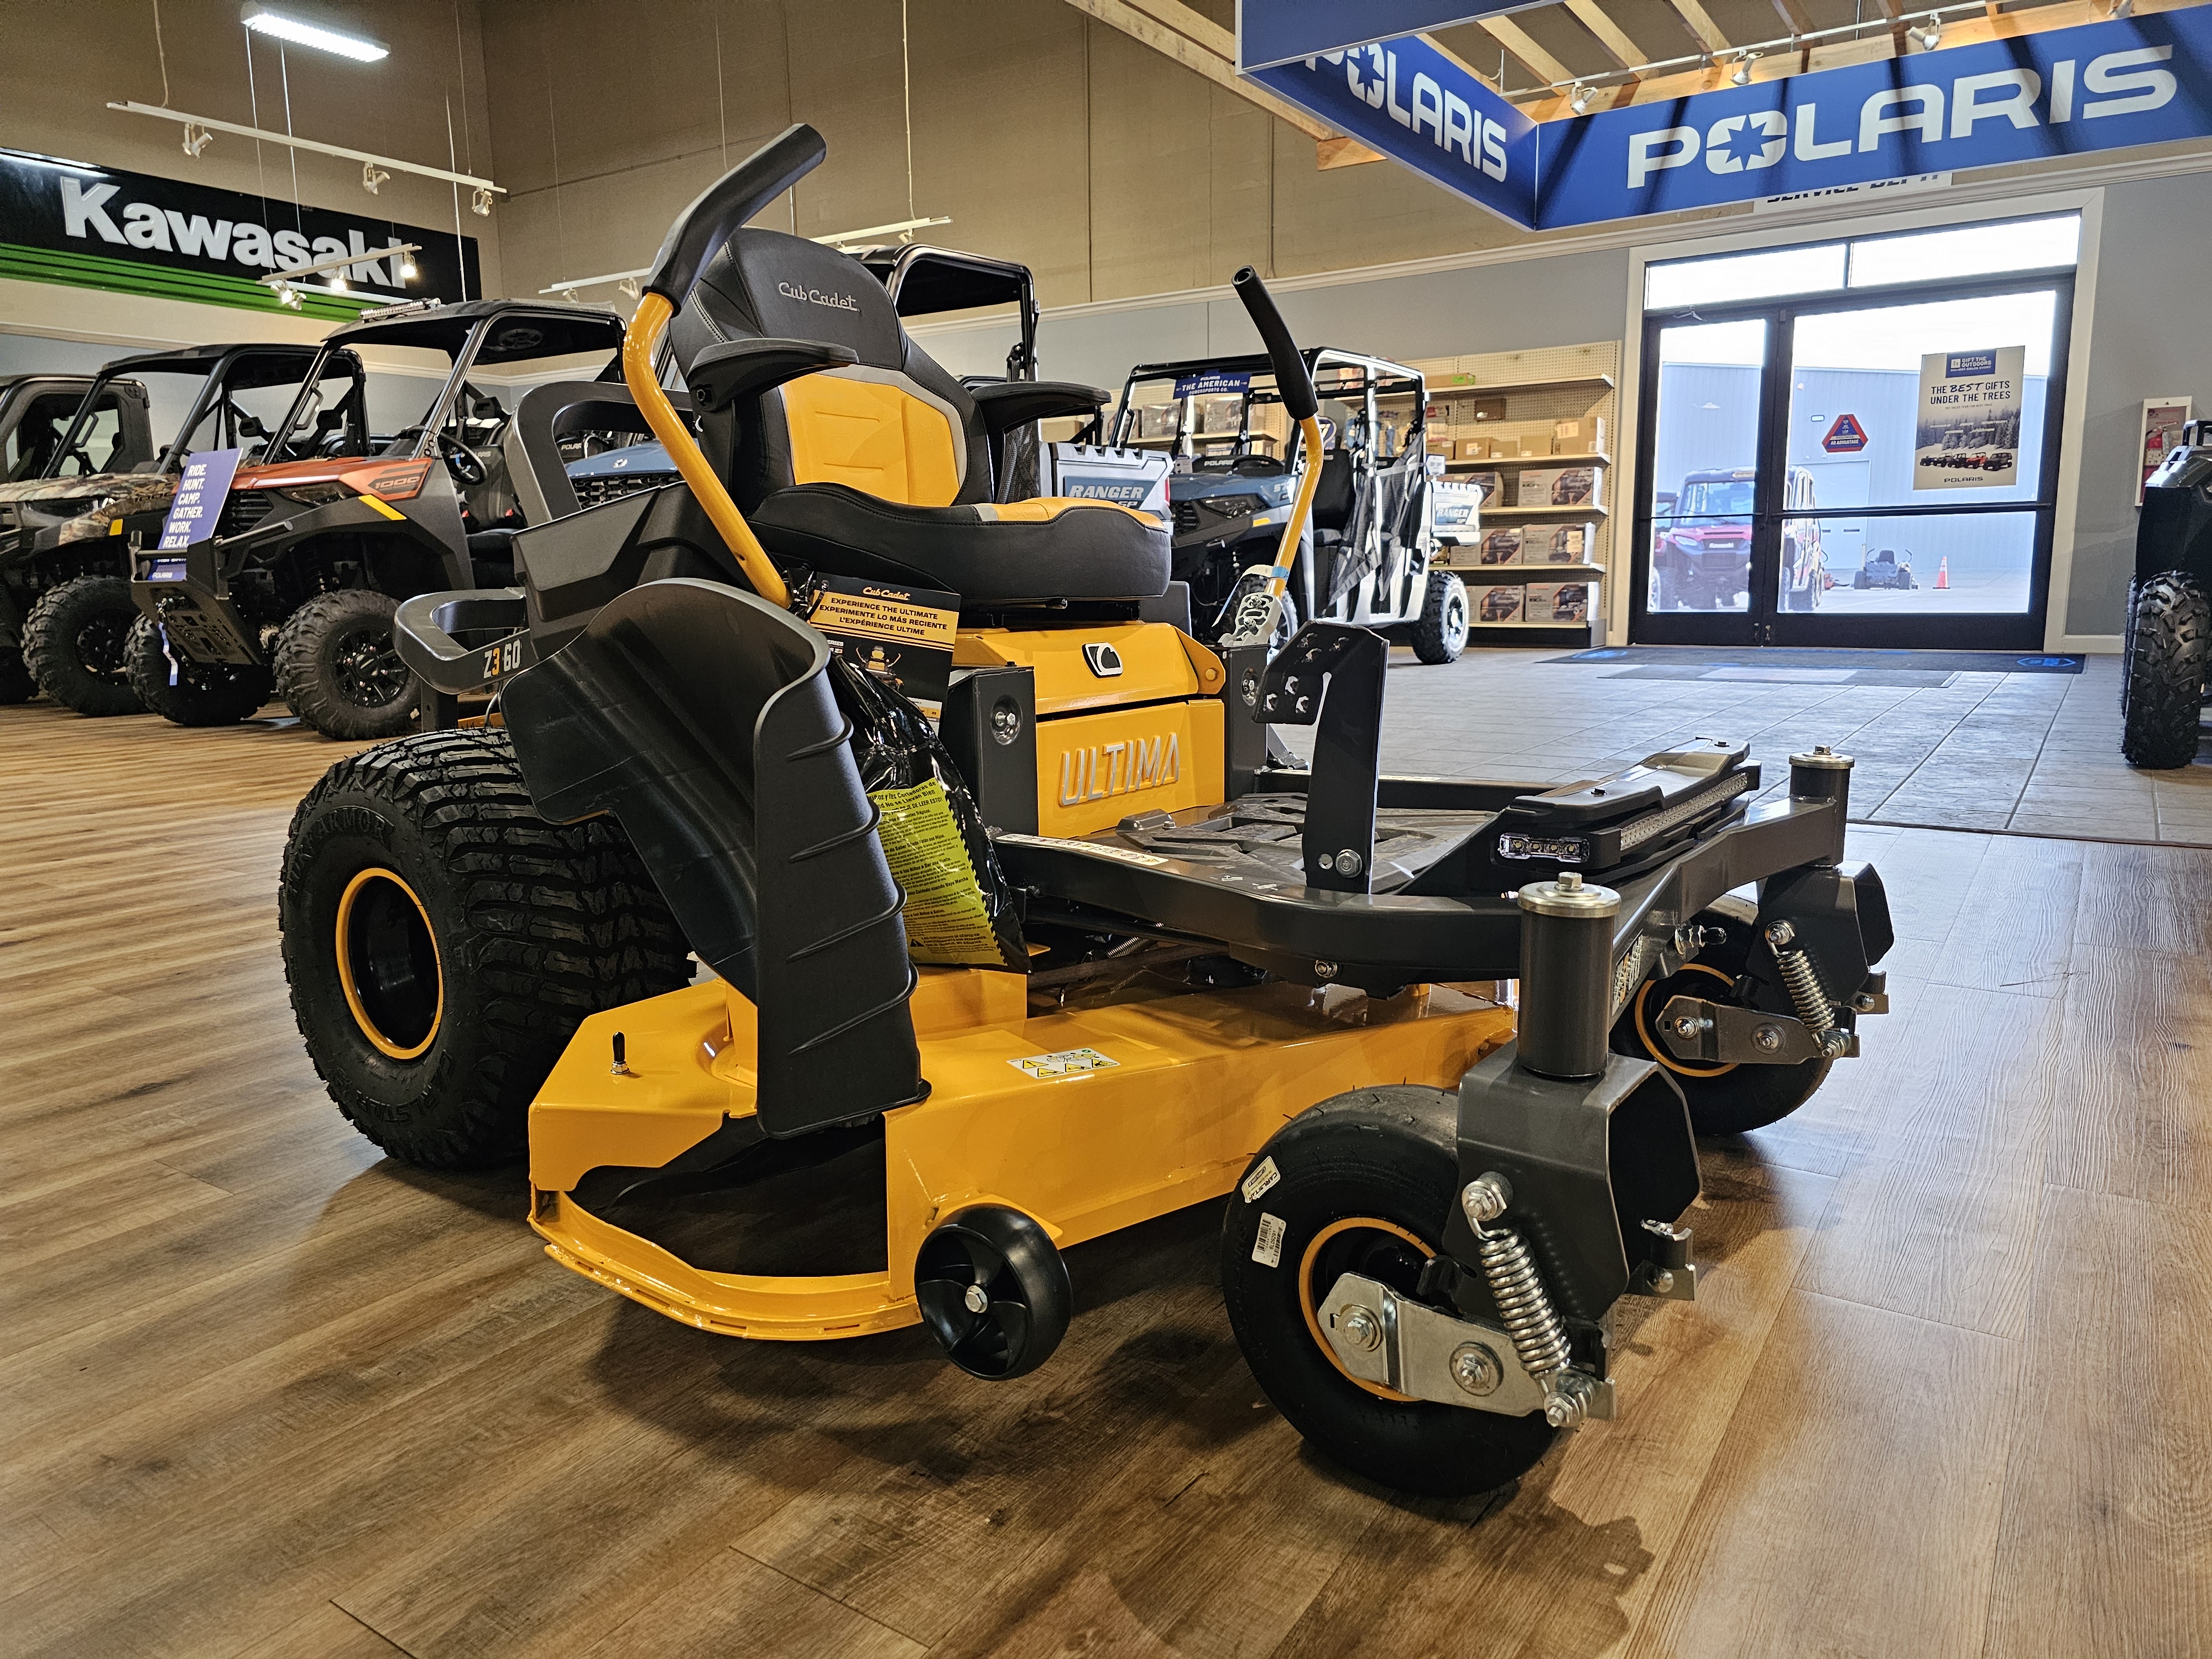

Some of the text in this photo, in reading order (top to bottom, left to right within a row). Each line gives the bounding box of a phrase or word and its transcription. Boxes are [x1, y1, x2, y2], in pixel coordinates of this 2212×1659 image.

[1306, 43, 1507, 182] OLARIS
[1627, 45, 2177, 190] POLARIS
[60, 176, 406, 289] Kawasaki
[778, 281, 858, 311] Cub Cadet
[1182, 380, 1240, 392] THE AMERICAN
[1931, 380, 2010, 394] THE BEST GIFTS
[1931, 391, 2011, 405] UNDER THE TREES
[187, 464, 207, 477] RIDE.
[182, 478, 205, 491] HUNT.
[375, 476, 420, 489] 1000
[178, 492, 200, 505] CAMP.
[1068, 485, 1144, 499] RANGER
[173, 506, 204, 519] GATHER.
[1437, 508, 1469, 517] RANGER
[169, 521, 192, 534] WORK.
[163, 535, 190, 548] RELAX.
[863, 587, 910, 601] Cub Cadet
[831, 598, 880, 611] EXPERIENCE
[900, 608, 938, 619] ULTIMATE
[819, 604, 875, 618] EXPERIMENTE
[909, 619, 947, 630] RECIENTE
[839, 617, 925, 635] L'EXPÉRIENCE ULTIME
[1058, 732, 1180, 807] ULTIMA
[897, 784, 928, 799] Cortadoras
[902, 794, 922, 804] Llevan
